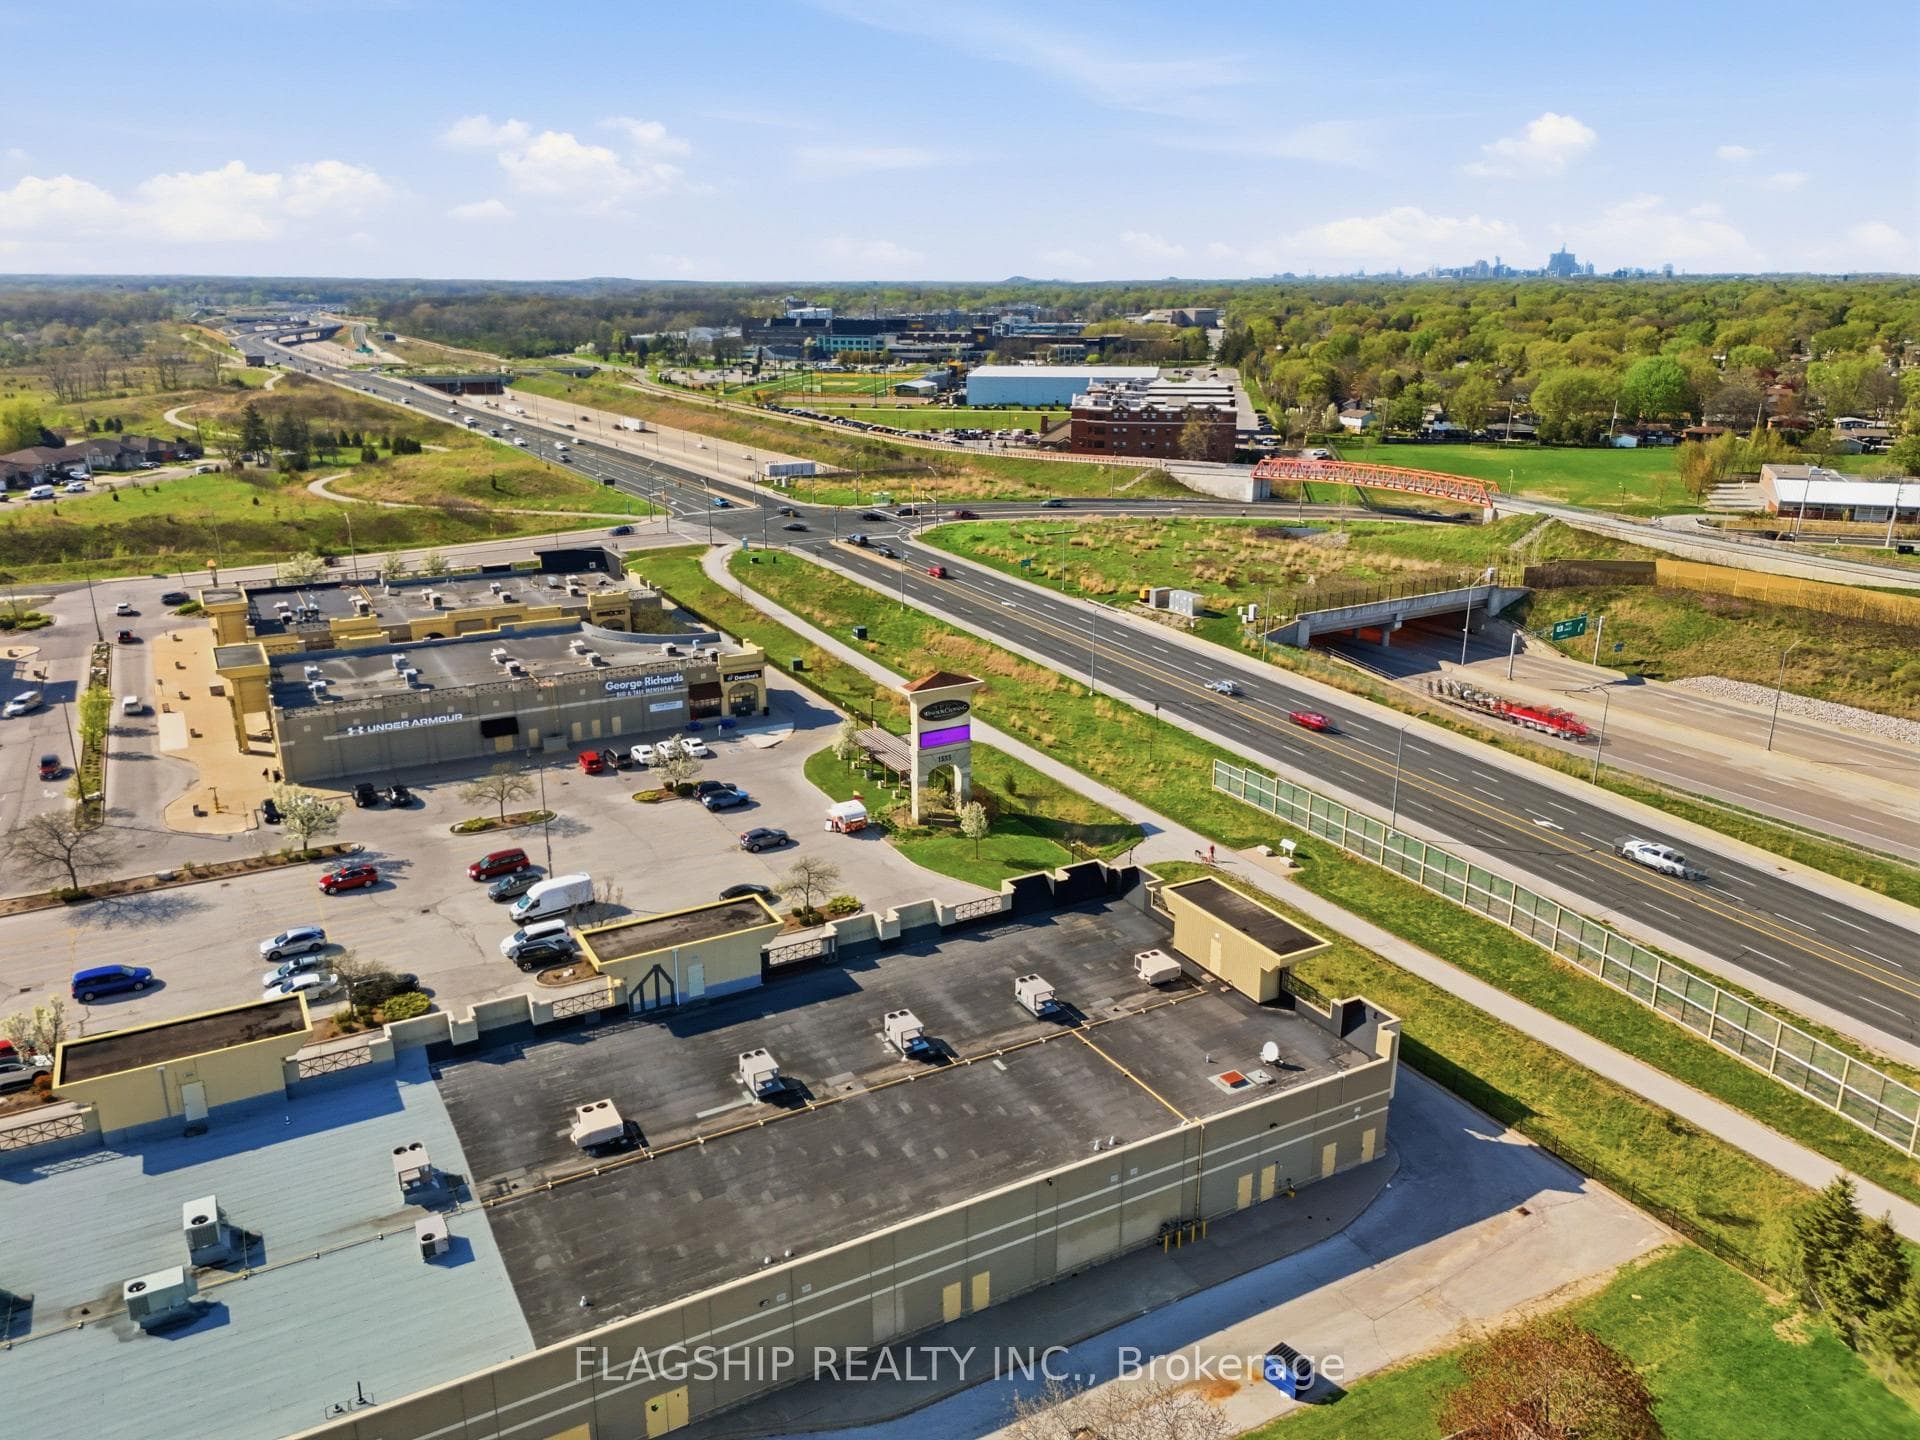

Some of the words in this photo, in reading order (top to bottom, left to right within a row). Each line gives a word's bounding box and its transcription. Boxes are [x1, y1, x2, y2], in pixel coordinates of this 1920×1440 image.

[605, 680, 642, 691] George
[644, 673, 684, 687] Richards
[367, 720, 409, 733] UNDER
[411, 713, 463, 727] ARMOUR
